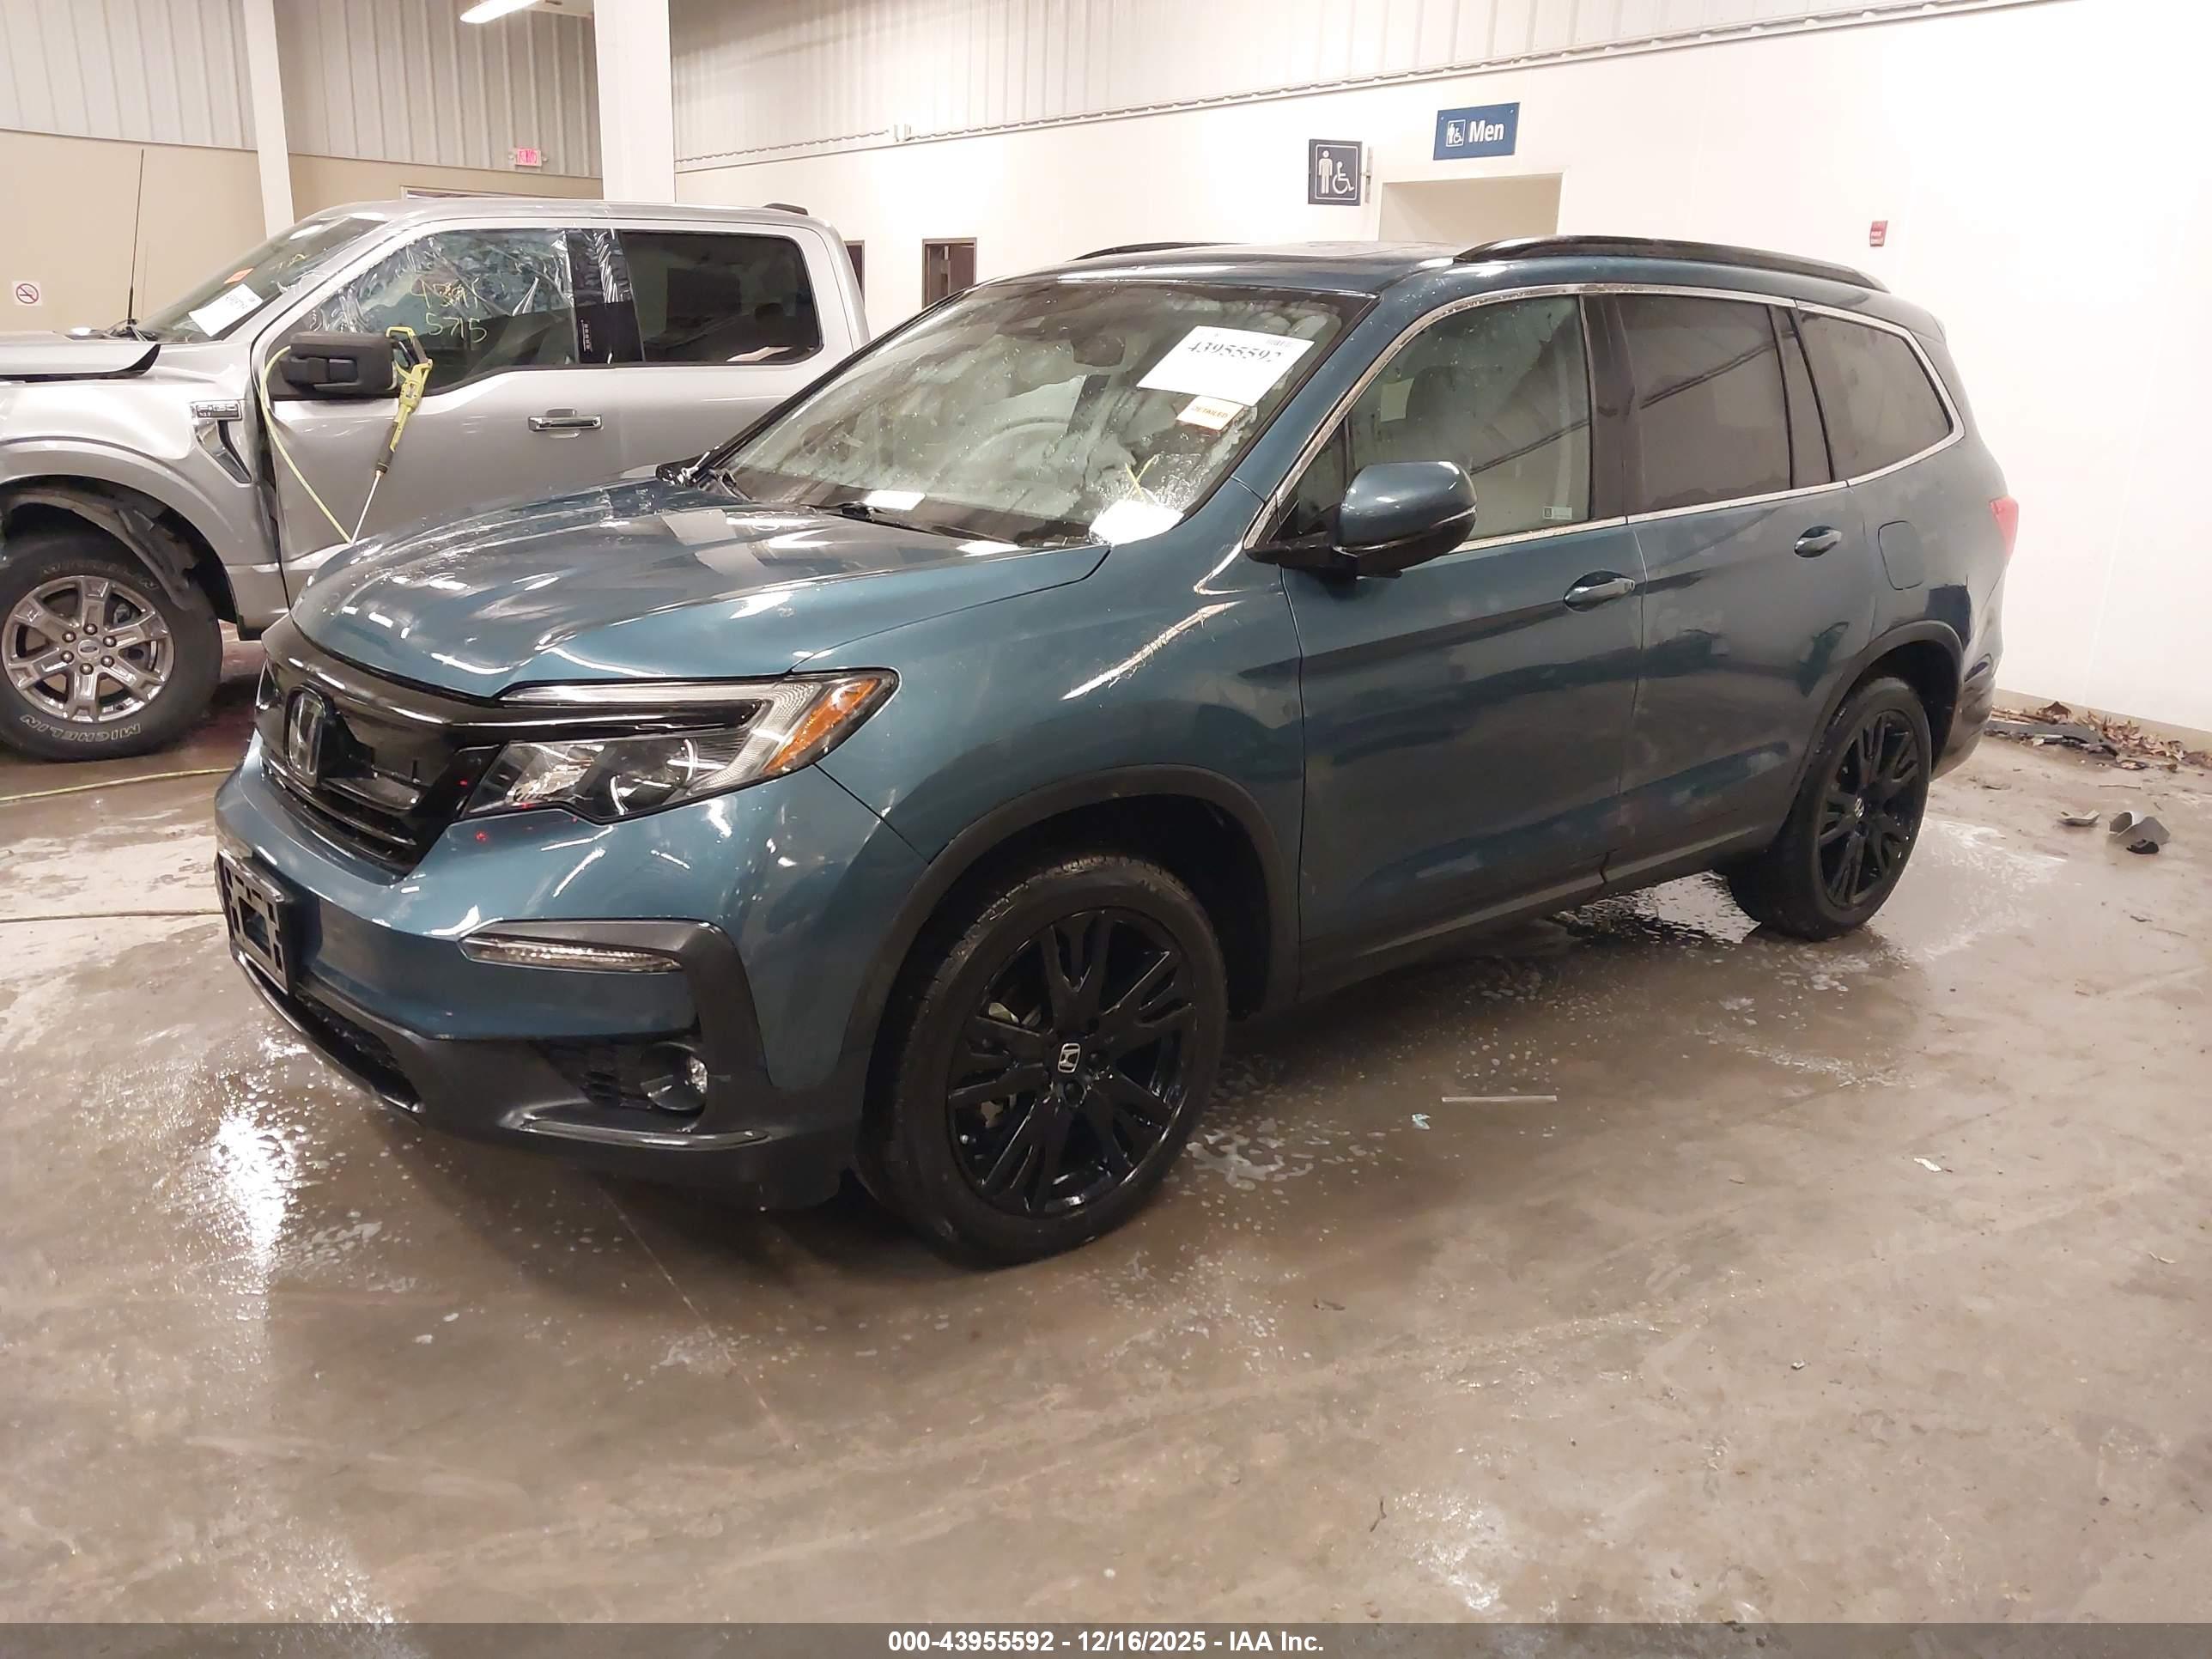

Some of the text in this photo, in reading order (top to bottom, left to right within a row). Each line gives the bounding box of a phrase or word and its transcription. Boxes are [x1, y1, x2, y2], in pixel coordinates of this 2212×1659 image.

[1468, 119, 1504, 143] Men
[425, 312, 488, 343] 5715
[1190, 404, 1230, 419] DETAILED
[20, 714, 142, 743] MICHELIN
